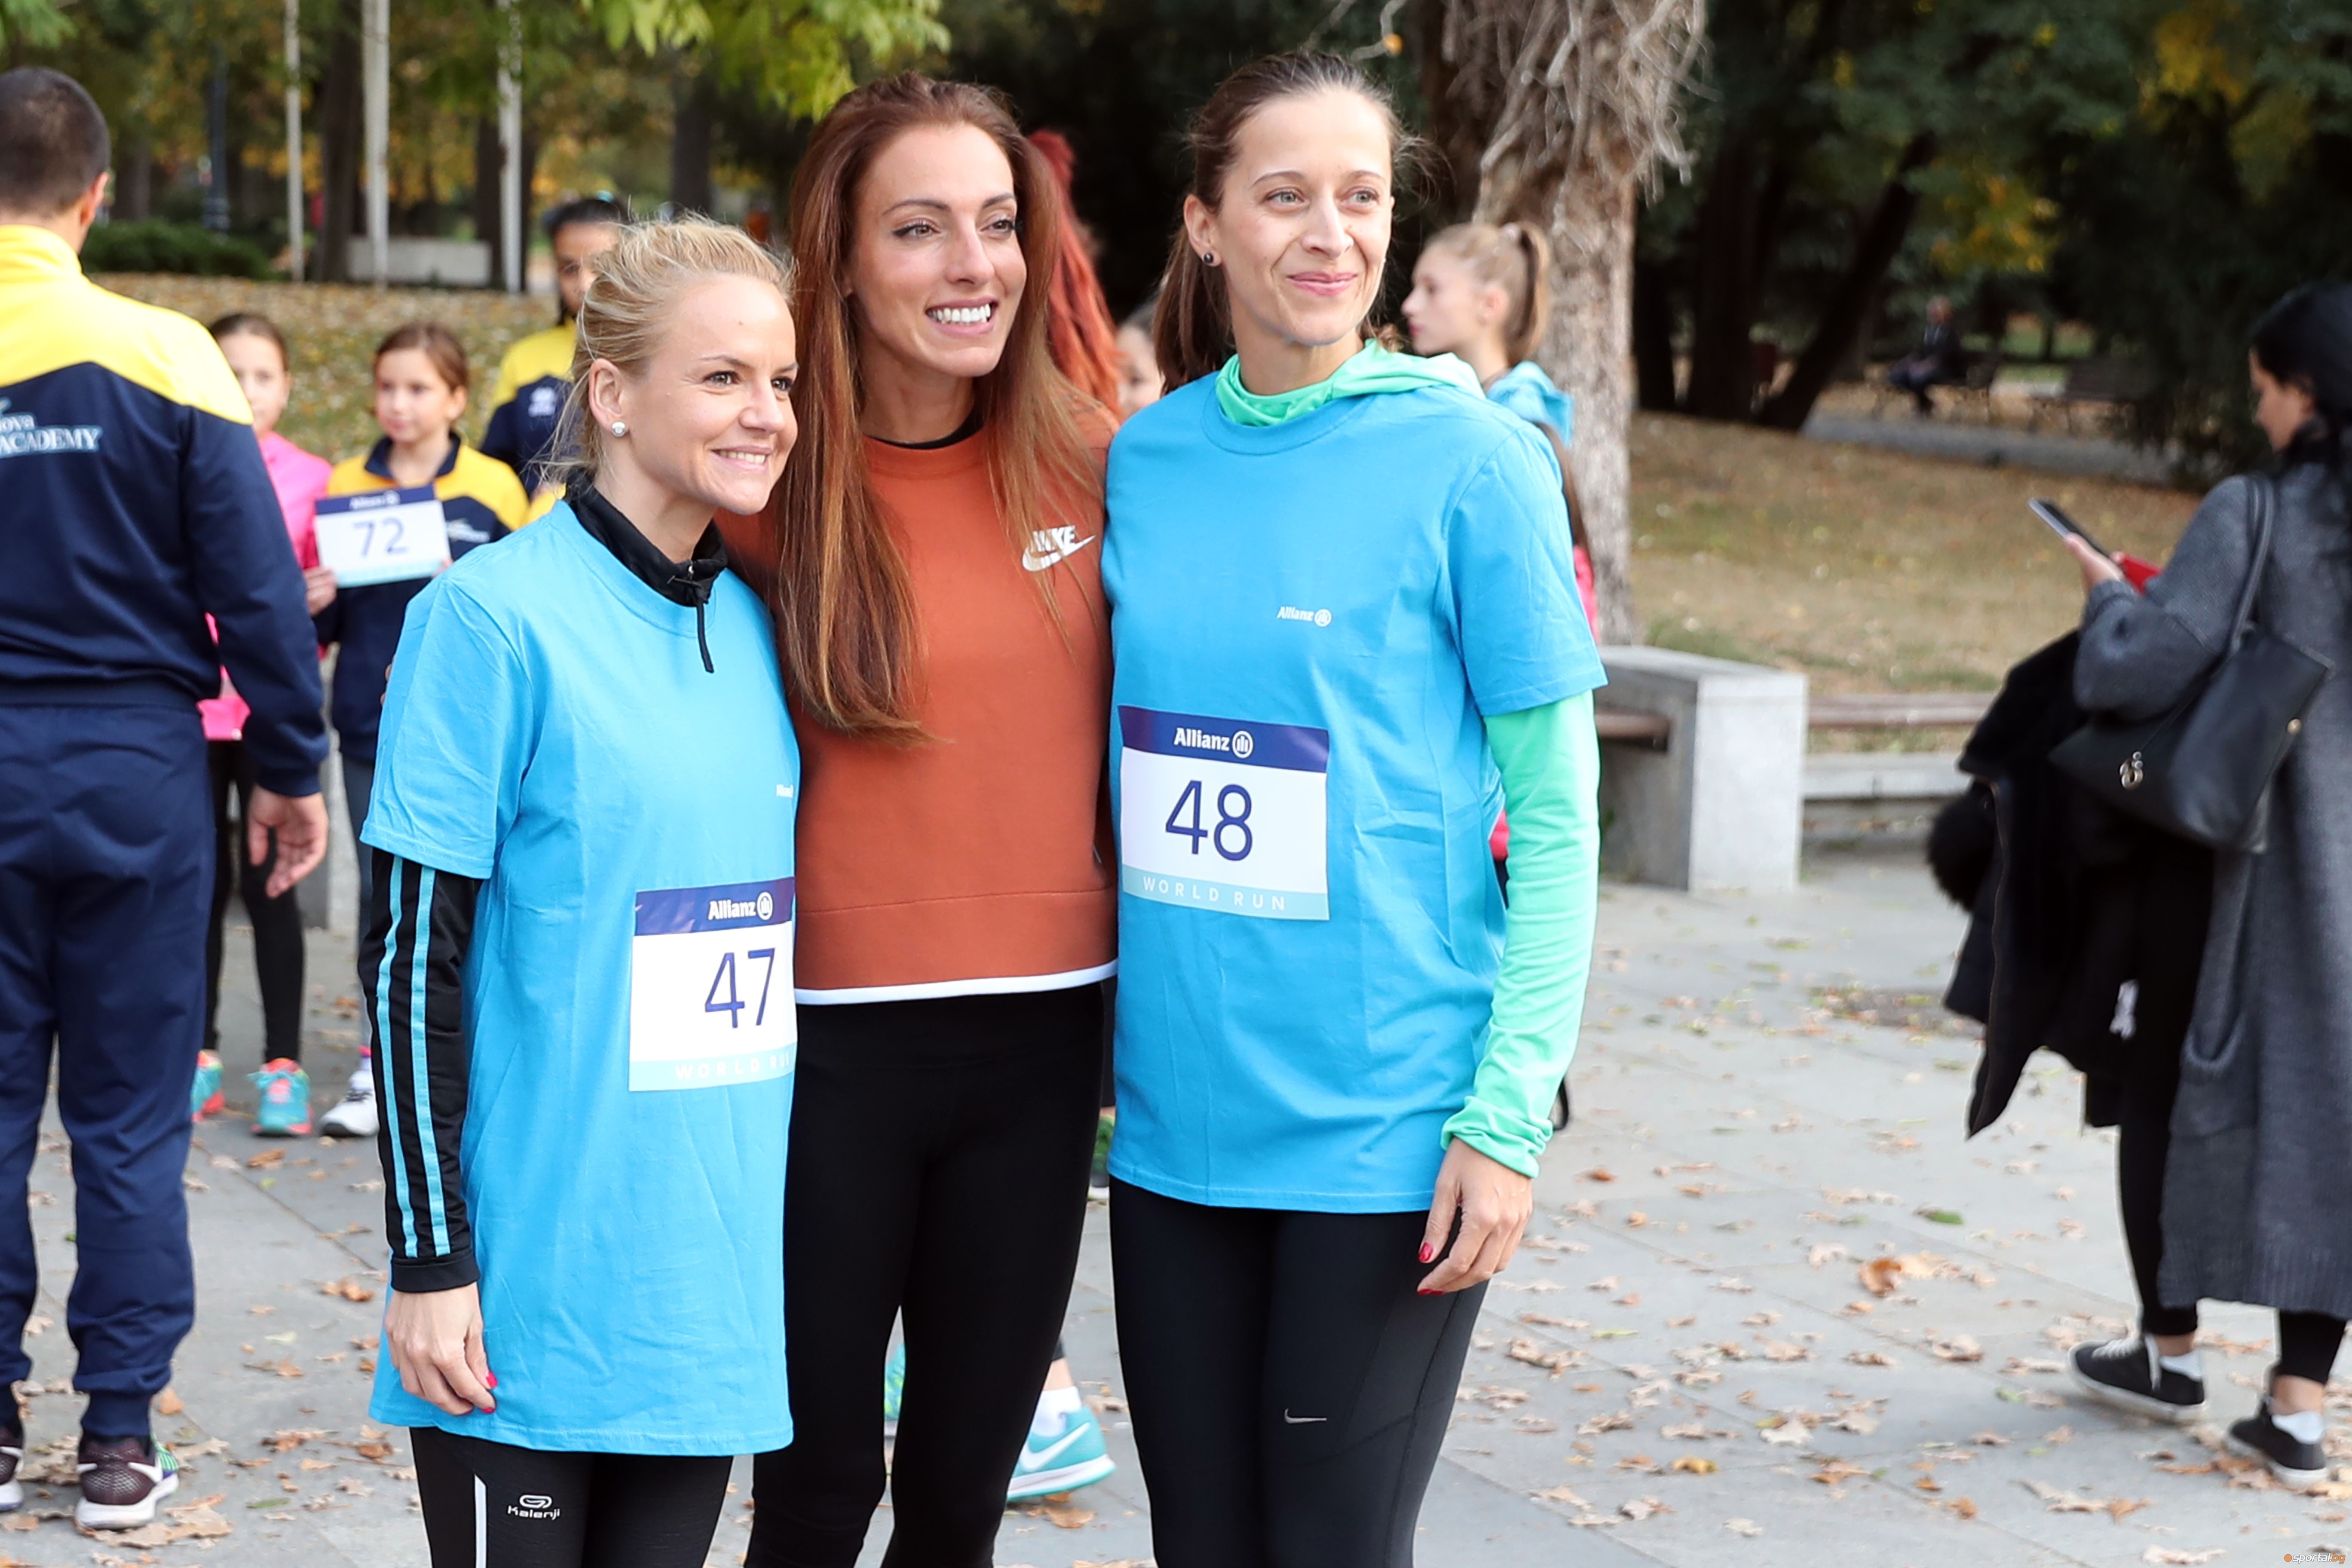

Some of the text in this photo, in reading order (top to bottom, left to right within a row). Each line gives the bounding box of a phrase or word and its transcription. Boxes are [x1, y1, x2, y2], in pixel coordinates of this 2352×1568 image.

[0, 414, 35, 433] ova
[353, 517, 409, 557] 72
[1277, 606, 1314, 622] Allianz
[1173, 727, 1230, 751] Allianz
[1165, 780, 1253, 861] 48
[1142, 876, 1286, 910] WORLD RUN
[707, 900, 756, 920] Allianz
[704, 947, 775, 1028] 47
[674, 1057, 760, 1081] WORLD
